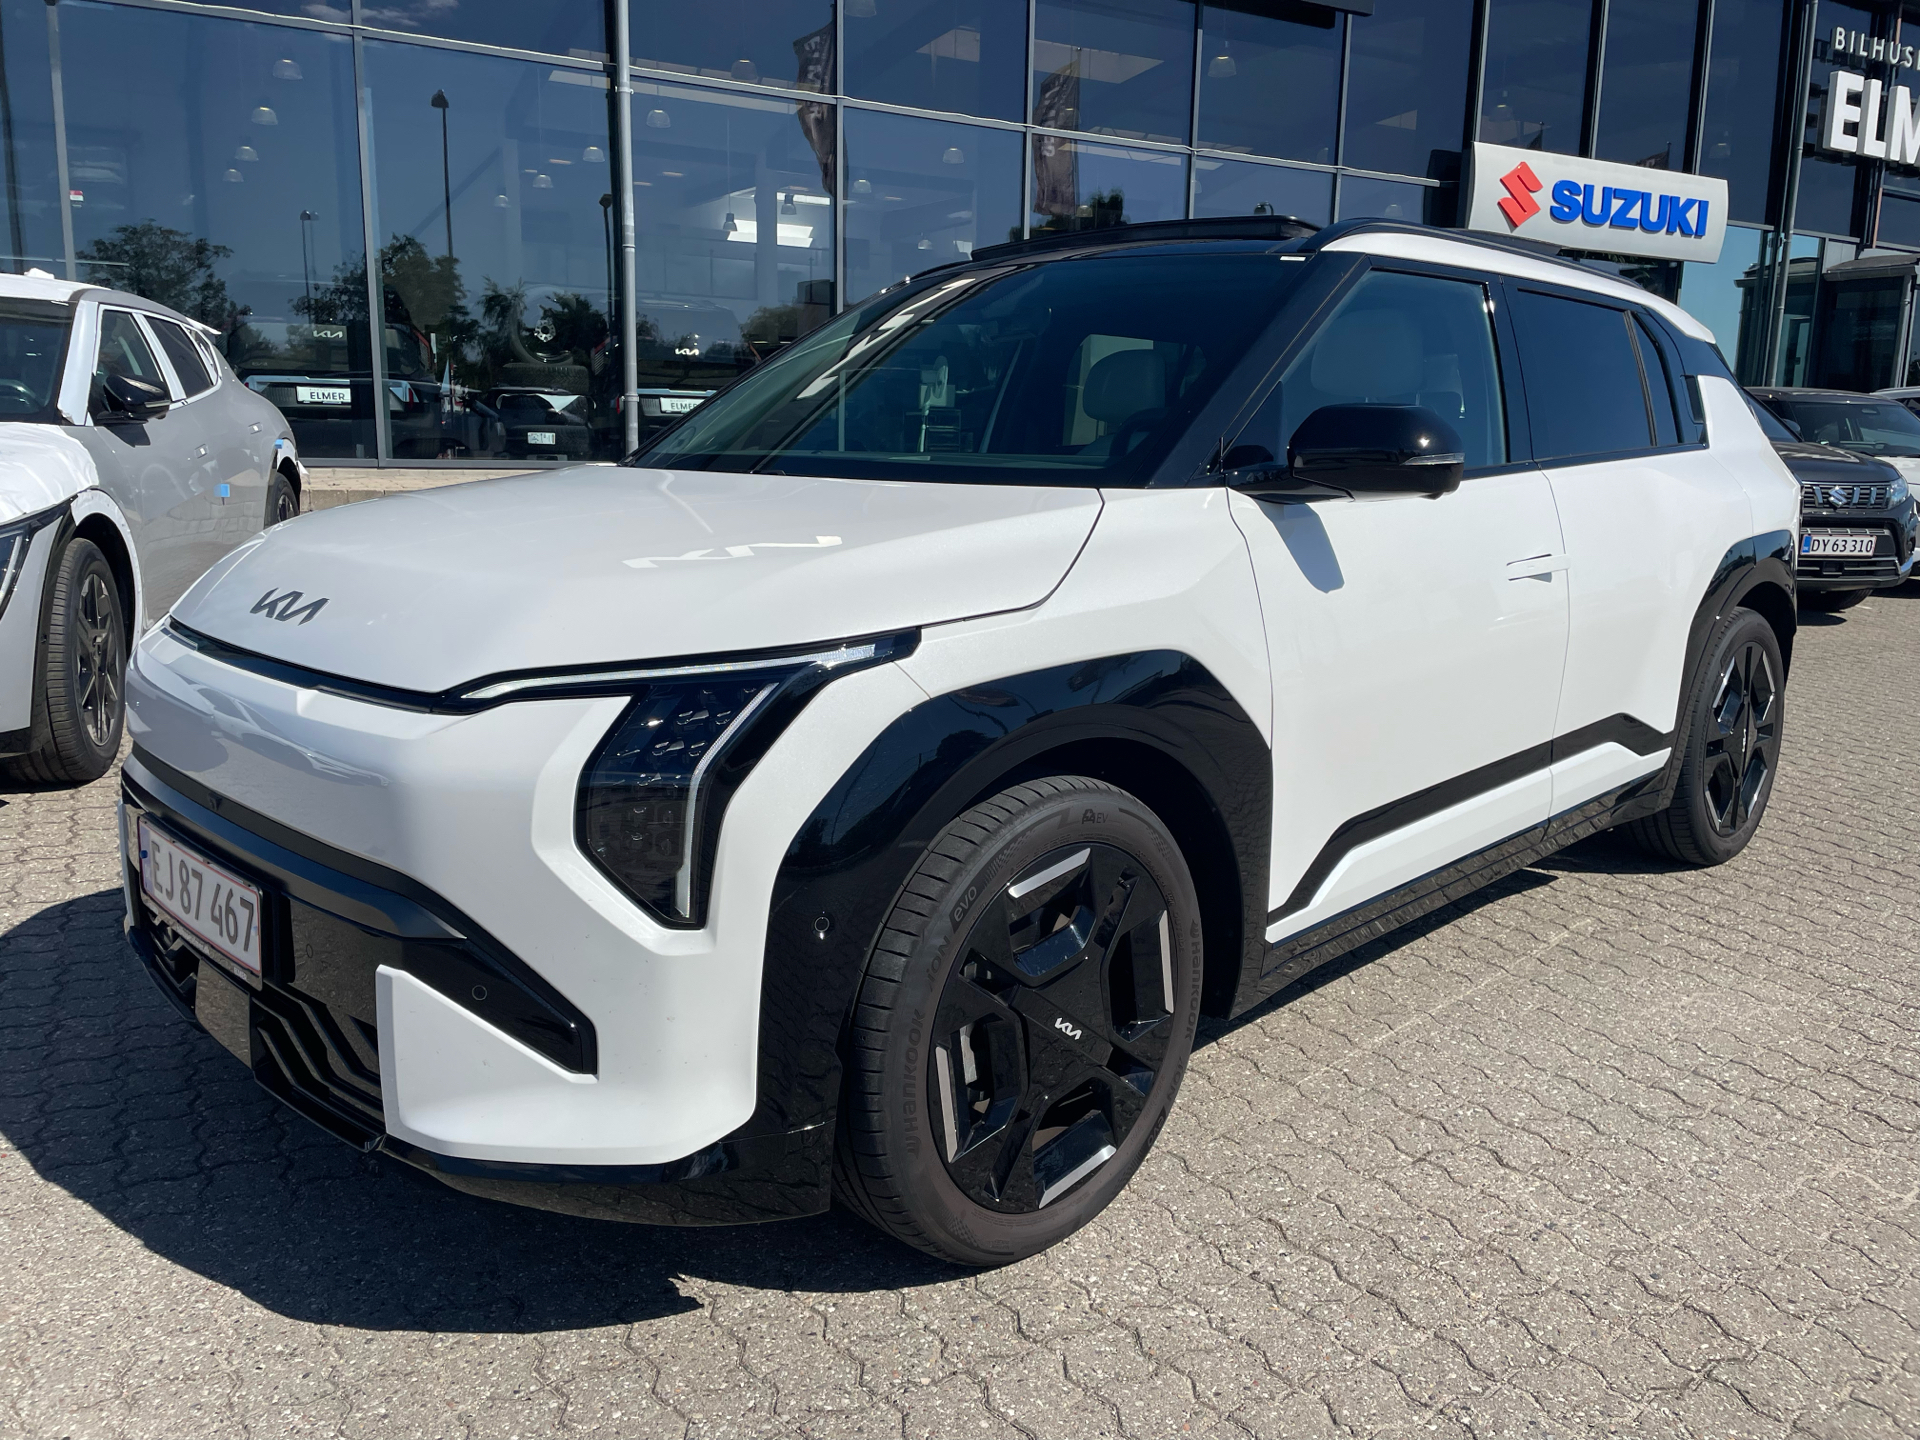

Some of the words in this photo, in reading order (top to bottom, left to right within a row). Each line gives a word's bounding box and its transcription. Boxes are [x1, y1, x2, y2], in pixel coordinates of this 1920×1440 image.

[1834, 26, 1920, 71] BILHUS
[1550, 179, 1709, 237] SUZUKI
[309, 391, 345, 401] ELMER
[1811, 538, 1830, 552] DY
[1831, 538, 1848, 553] 63
[1849, 539, 1874, 553] 310
[249, 587, 331, 626] KIA
[151, 840, 174, 901] EJ
[178, 859, 203, 921] 87
[210, 883, 254, 952] 467
